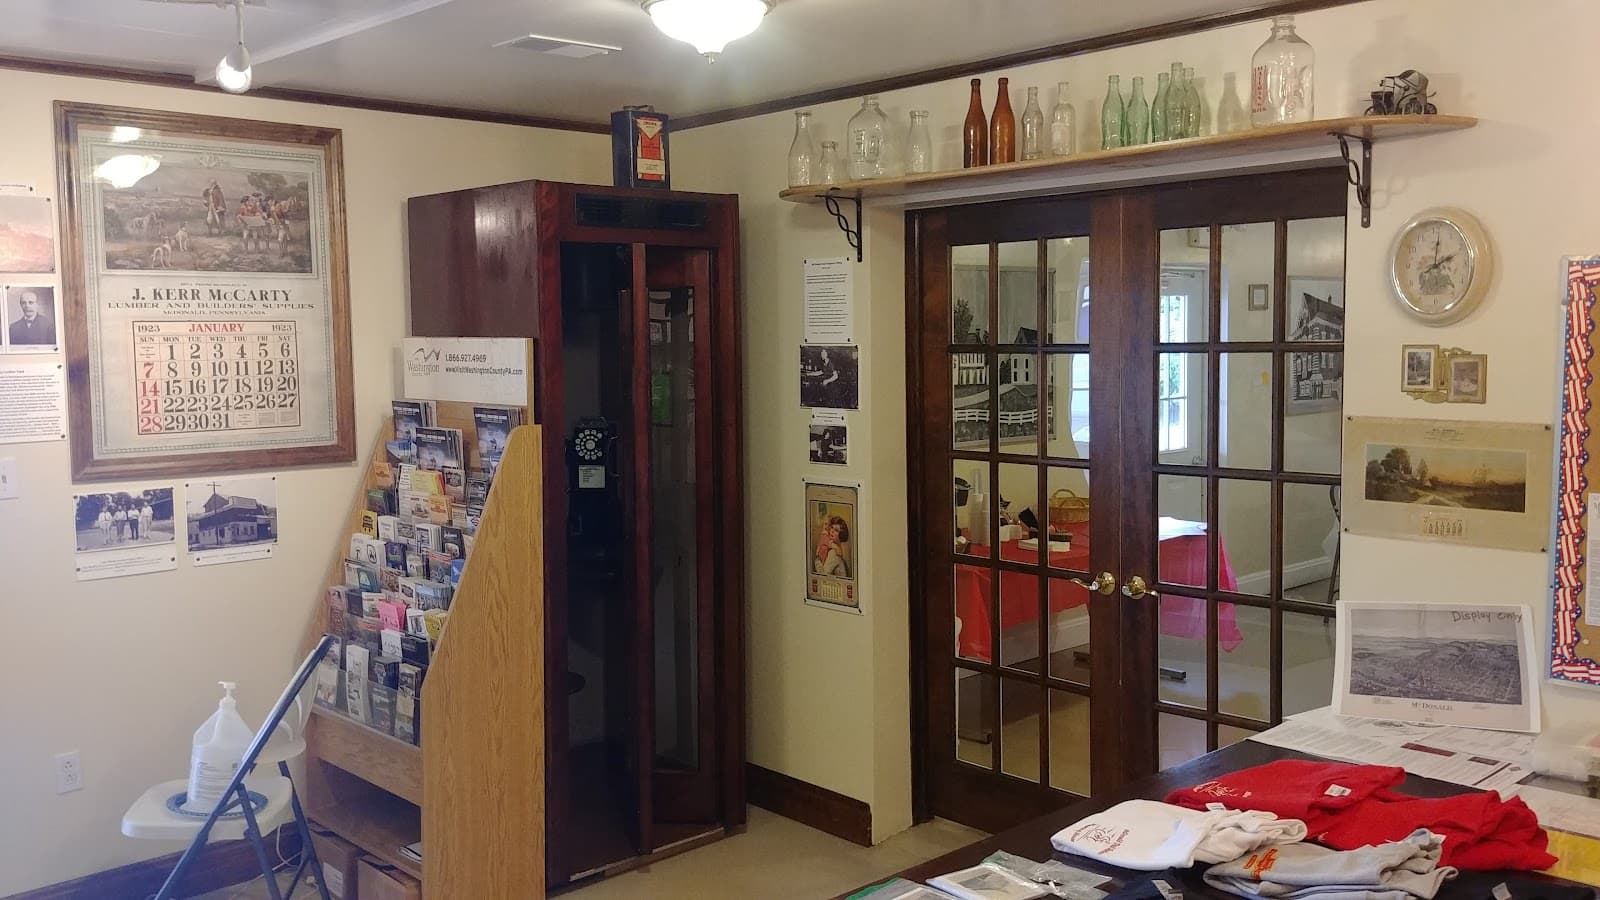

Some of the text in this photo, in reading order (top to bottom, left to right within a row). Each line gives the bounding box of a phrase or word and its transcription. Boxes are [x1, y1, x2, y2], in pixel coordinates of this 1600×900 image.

[132, 288, 292, 301] J. KERR McCARTY
[138, 323, 292, 333] 1923 JANUARY 1923
[168, 344, 177, 360] 1
[190, 343, 201, 360] 2
[213, 343, 224, 359] 3
[236, 343, 248, 359] 4
[258, 342, 269, 358] 5
[280, 342, 290, 358] 6
[143, 359, 295, 378] 7 8 9 10 11 12 13
[408, 361, 440, 373] Washington
[140, 375, 297, 397] 14 15 16 17 18 19 20
[141, 393, 298, 414] 21 22 23 24 25 26 27
[141, 416, 163, 433] 28
[165, 415, 186, 431] 29
[188, 413, 209, 430] 30
[212, 412, 231, 429] 31
[1452, 610, 1491, 623] Display
